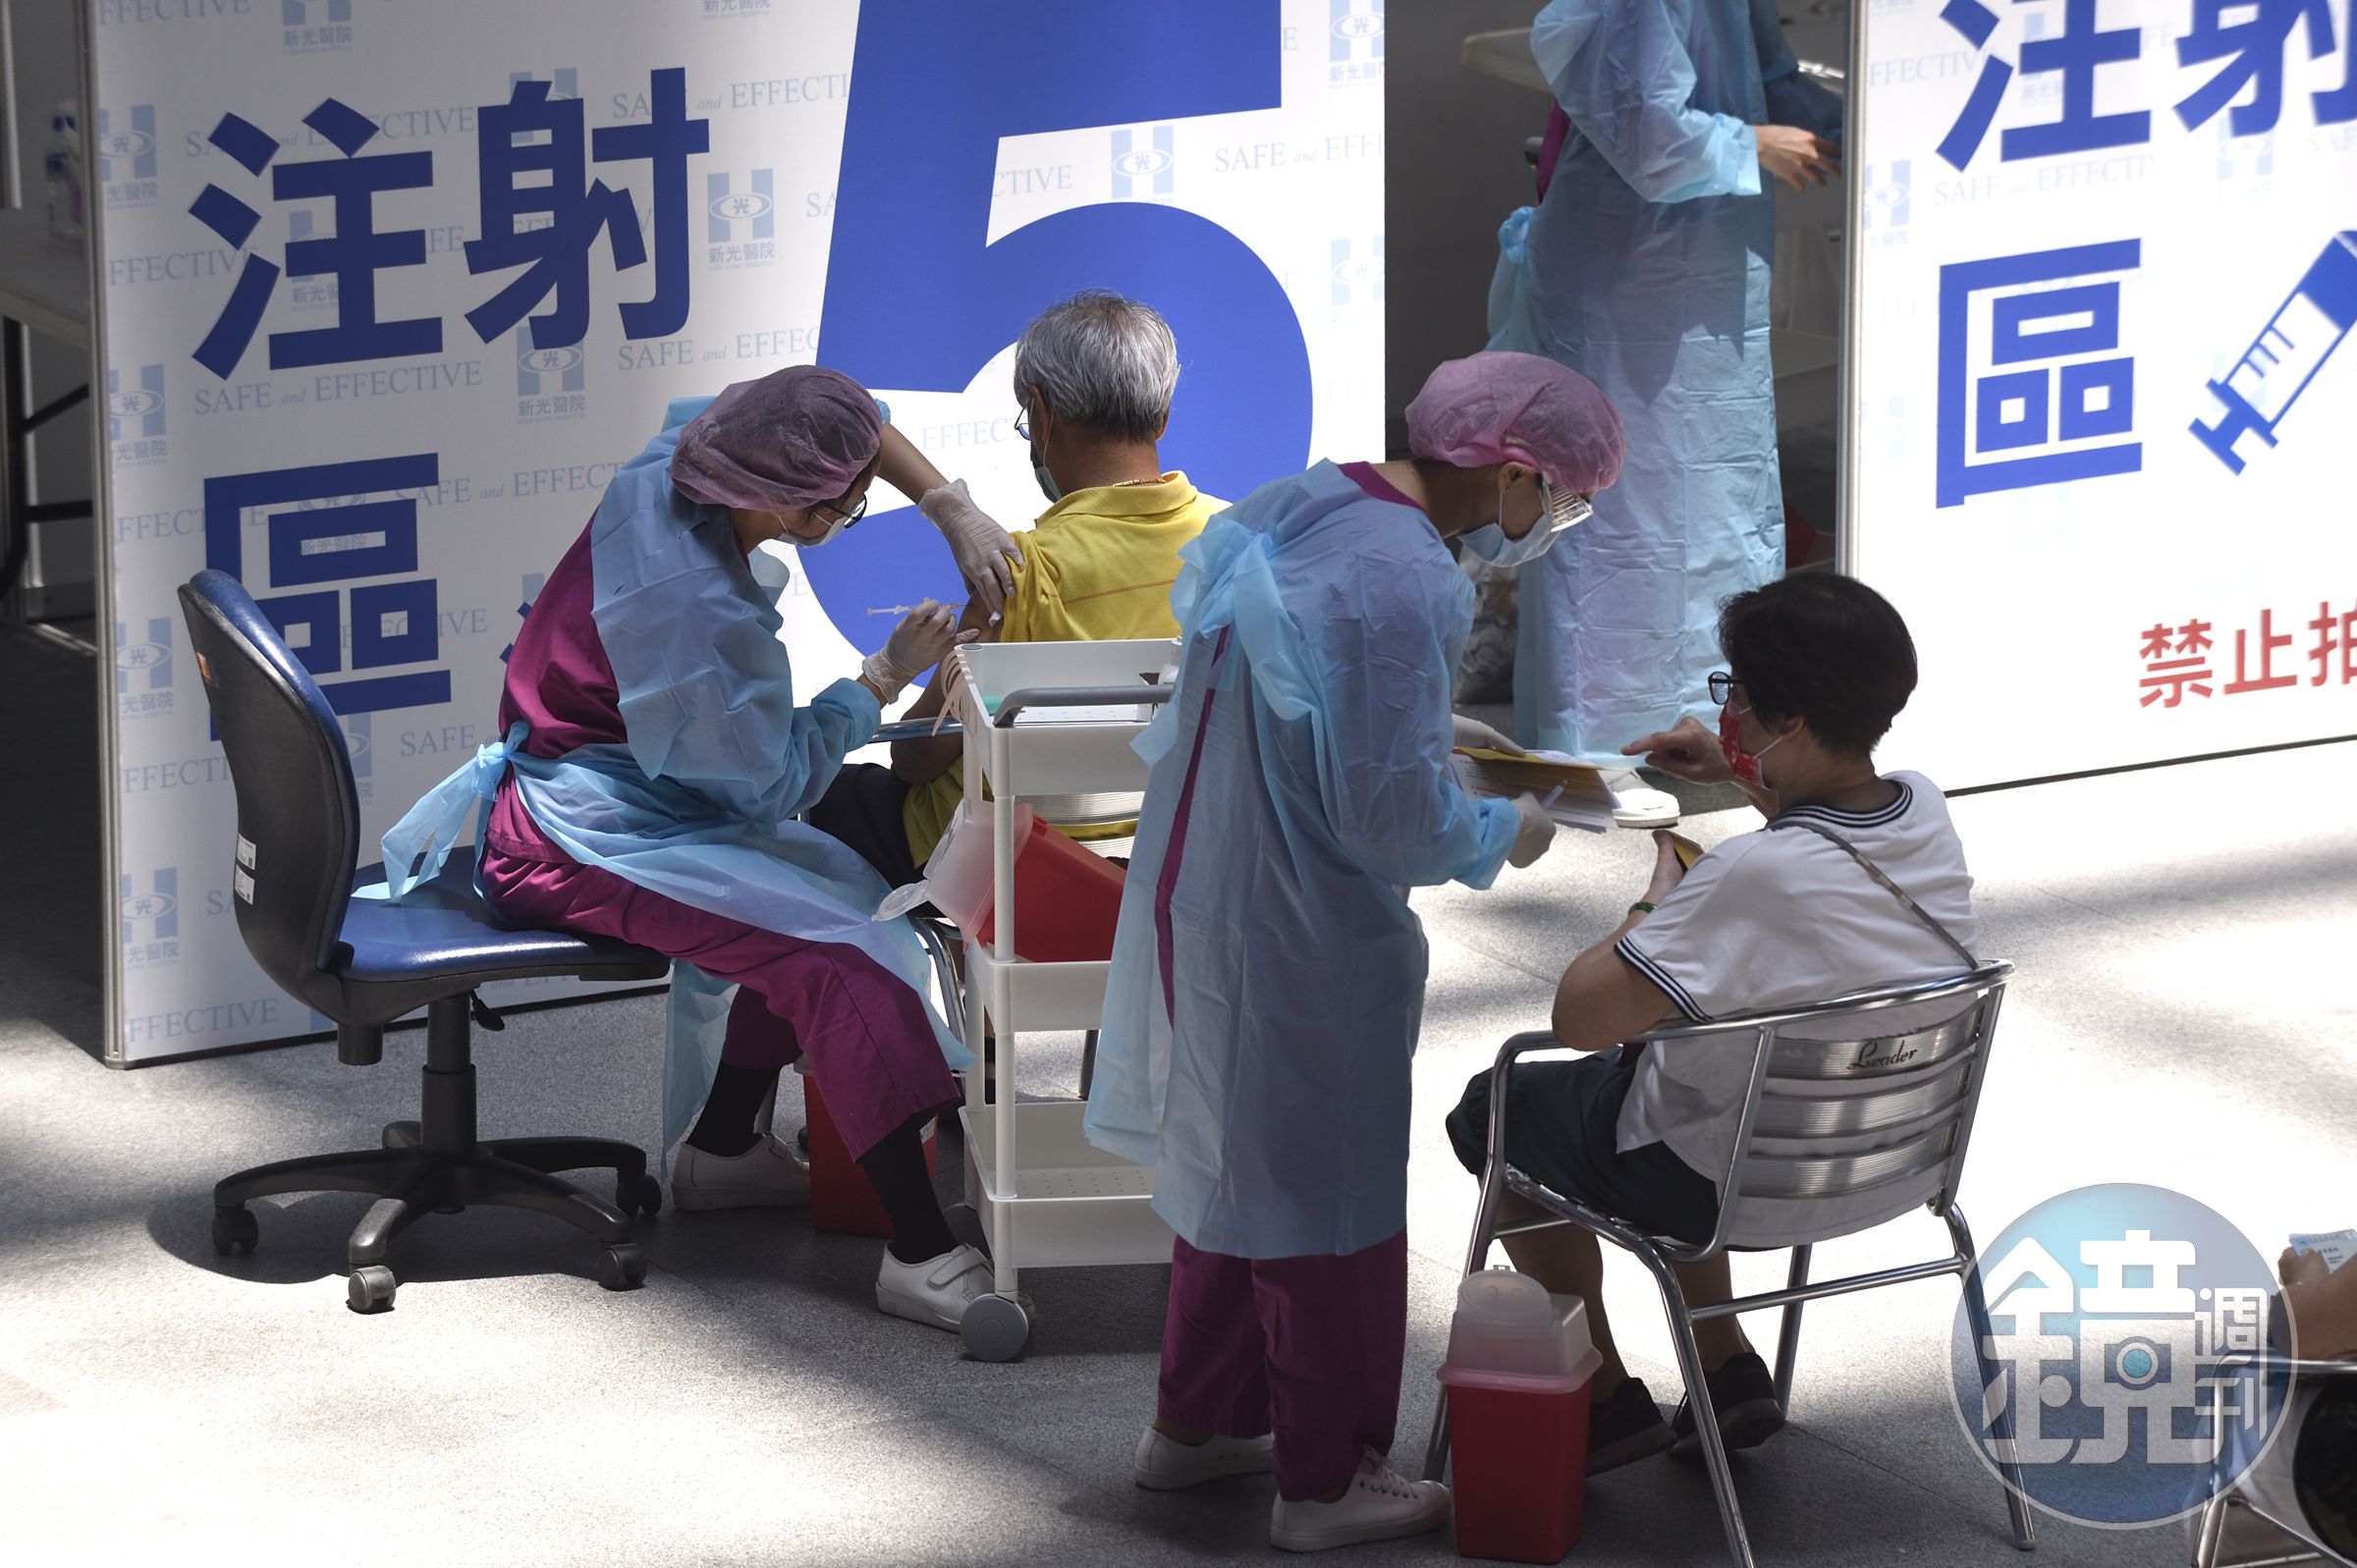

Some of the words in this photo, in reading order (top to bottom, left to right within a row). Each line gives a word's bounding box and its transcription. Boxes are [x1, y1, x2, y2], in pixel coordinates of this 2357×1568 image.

[1870, 47, 1994, 87] FFECTIV
[697, 95, 722, 110] and
[1215, 142, 1287, 173] SAFE
[1293, 148, 1318, 163] and
[1935, 175, 2001, 205] SAFE
[188, 67, 709, 381] 注射
[109, 245, 258, 285] FFECTIV
[708, 243, 775, 264] 新光醫院
[618, 340, 694, 371] SAFE
[702, 346, 727, 361] and
[795, 0, 1314, 687] 5
[195, 383, 272, 414] SAFE
[281, 389, 306, 405] and
[314, 360, 482, 402] EFFECTIVE
[1936, 239, 2143, 509] 區
[518, 395, 586, 417] 新光醫院
[112, 440, 168, 461] 光醫院
[479, 485, 504, 501] and
[203, 452, 452, 741] 區
[119, 691, 175, 715] 光醫院
[400, 725, 477, 757] SAFE
